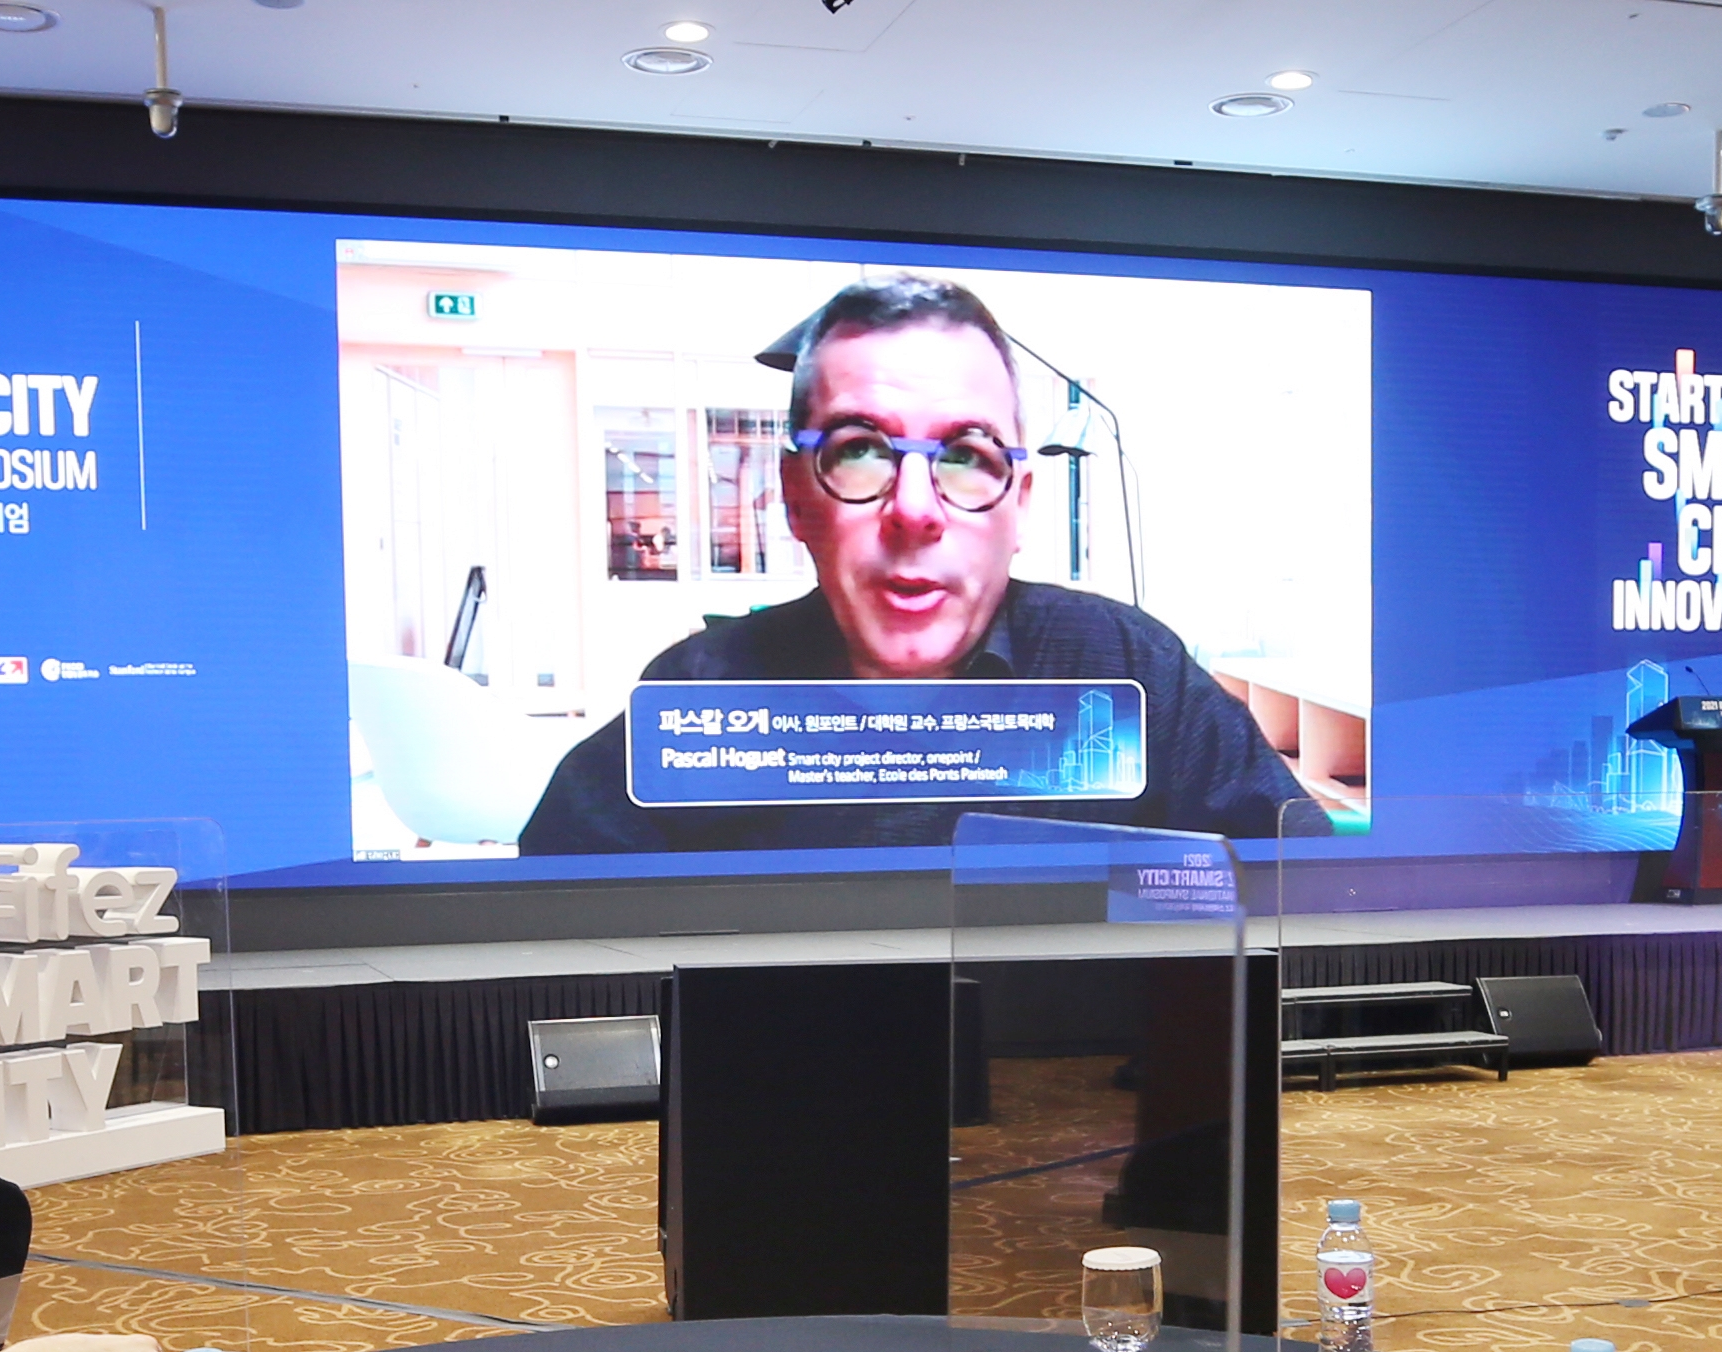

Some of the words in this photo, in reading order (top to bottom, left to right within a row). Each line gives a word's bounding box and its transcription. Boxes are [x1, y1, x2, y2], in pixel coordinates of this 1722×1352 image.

[659, 708, 724, 736] 파스칼
[726, 708, 770, 736] 오게
[805, 714, 858, 732] 원포인트
[867, 714, 908, 731] 대학원
[661, 747, 718, 768] Pascal
[720, 748, 787, 770] Hoguet
[788, 752, 821, 766] Smart
[822, 751, 841, 767] city
[843, 752, 880, 767] project
[881, 750, 925, 766] director,
[926, 750, 974, 765] onepoint
[788, 769, 833, 783] Master's
[834, 769, 877, 784] teacher,
[908, 768, 928, 782] des
[929, 767, 960, 781] Ponts
[960, 766, 1008, 781] Paristech
